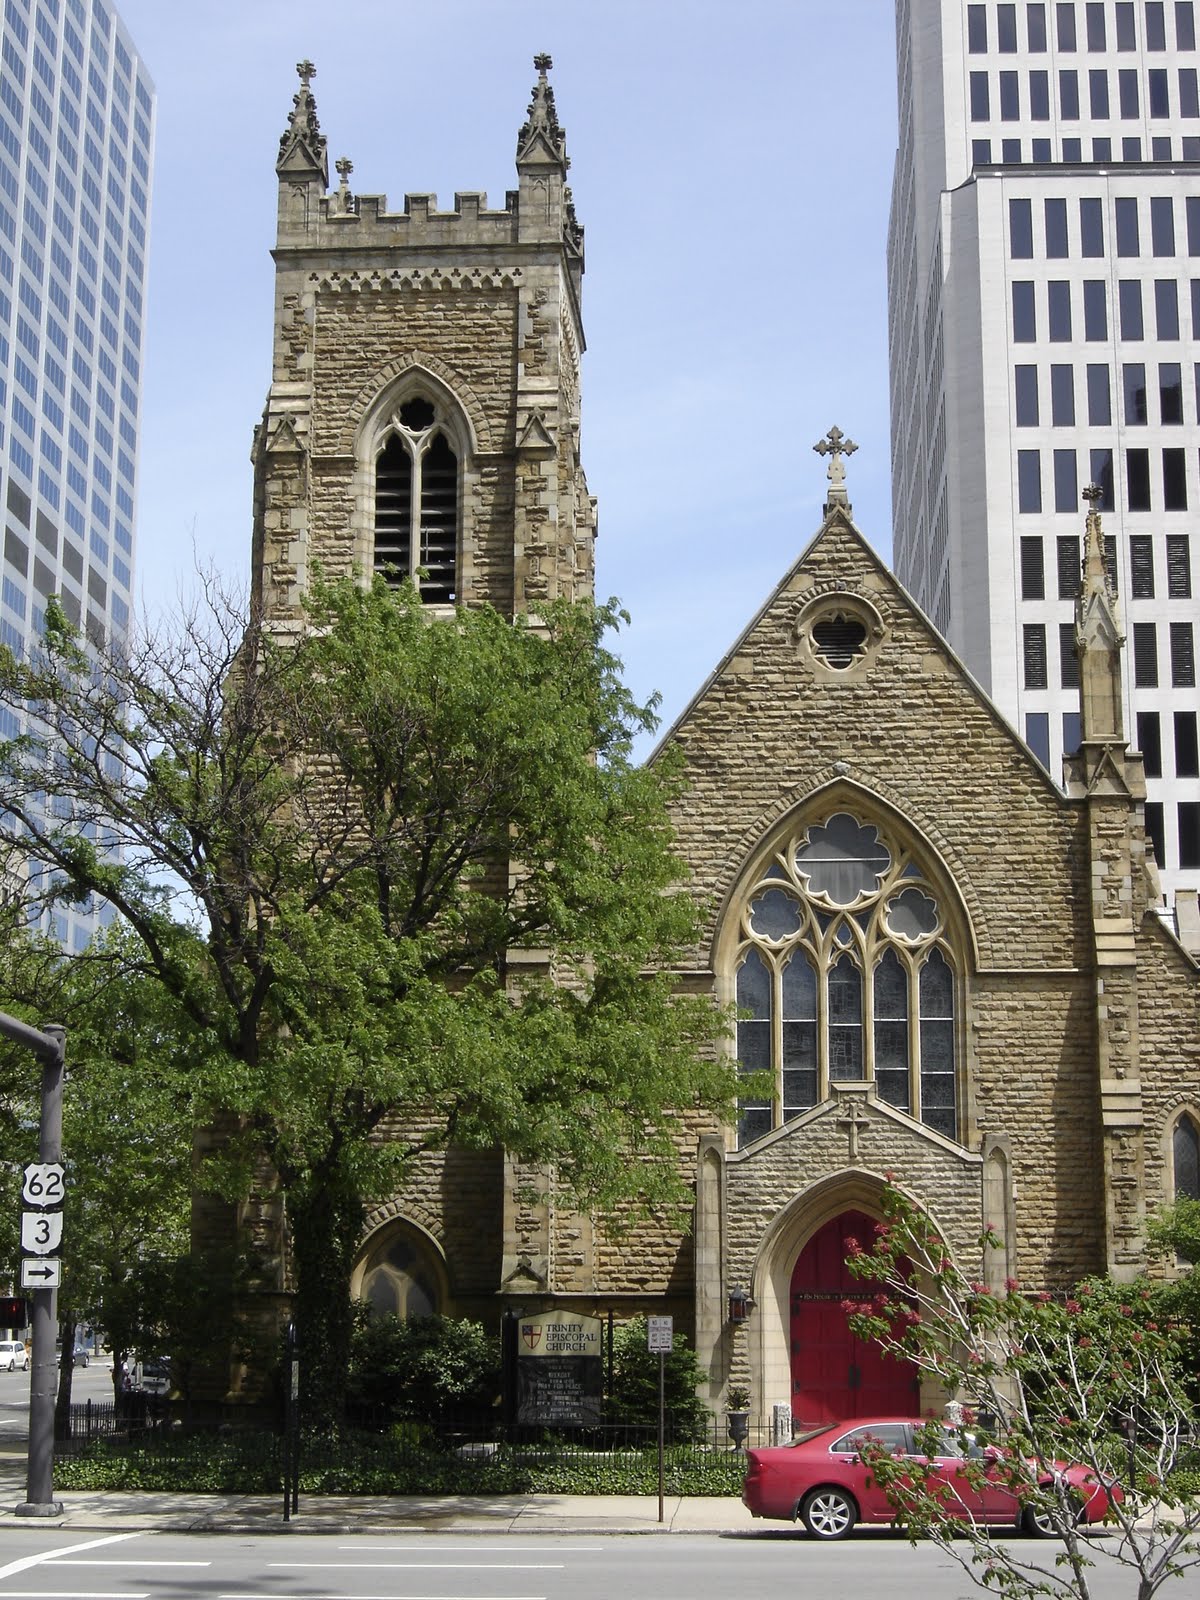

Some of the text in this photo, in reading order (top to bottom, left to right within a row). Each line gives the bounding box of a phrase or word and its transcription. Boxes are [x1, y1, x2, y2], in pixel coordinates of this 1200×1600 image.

[28, 1172, 61, 1196] 62
[34, 1219, 50, 1245] 3
[546, 1323, 584, 1332] TRINITY
[546, 1333, 597, 1342] EPISCOPAL
[545, 1342, 586, 1351] CHURCH
